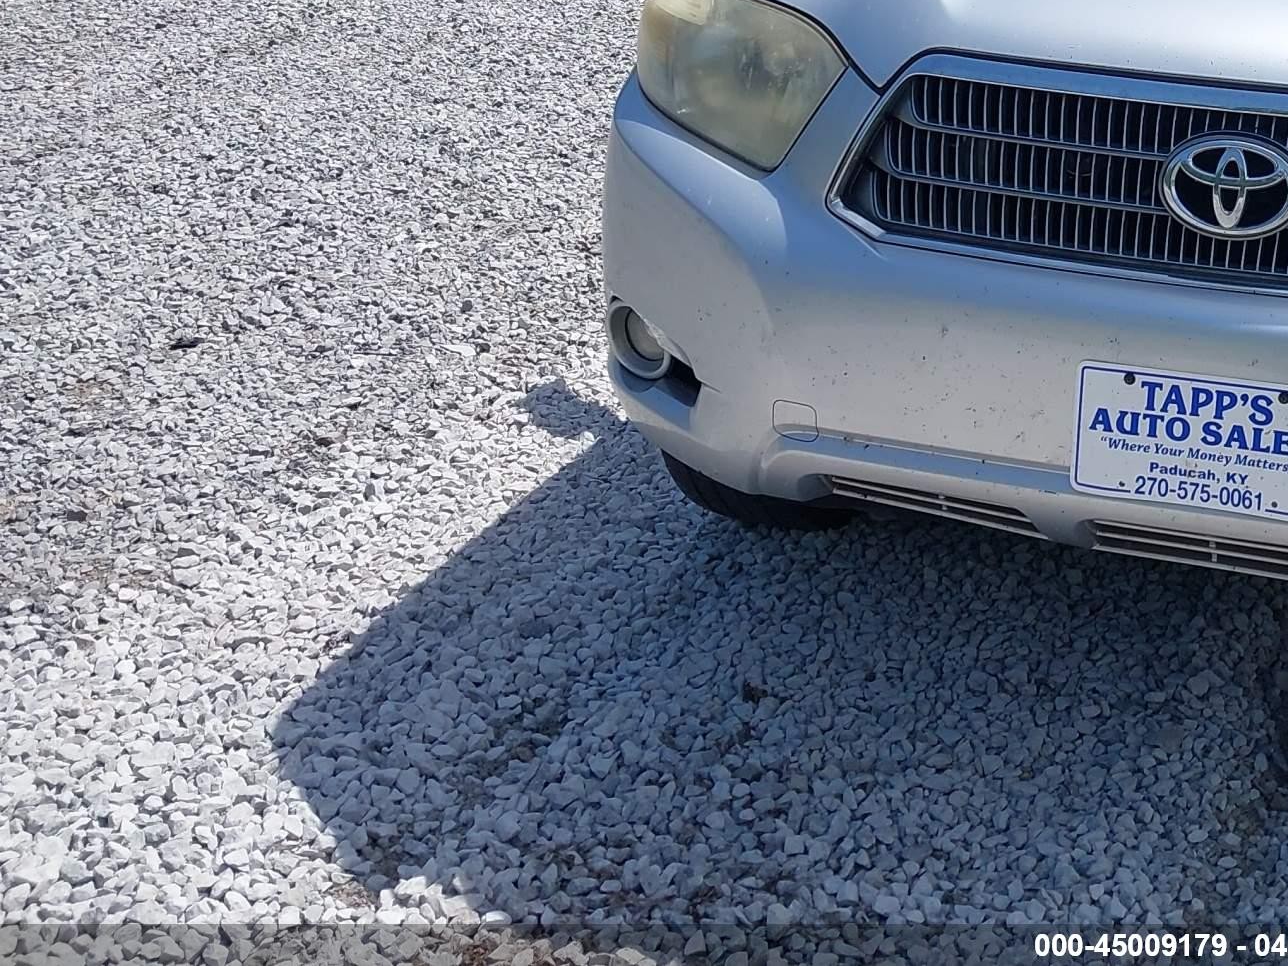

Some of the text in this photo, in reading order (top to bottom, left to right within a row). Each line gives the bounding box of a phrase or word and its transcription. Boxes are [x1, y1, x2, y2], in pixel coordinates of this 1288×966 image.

[1141, 380, 1274, 426] TAPP'S
[1089, 408, 1191, 442] AUTO
[1100, 436, 1150, 454] "Where
[1154, 443, 1184, 458] Your
[1187, 447, 1232, 465] Money
[1149, 462, 1248, 485] Paducah, KY
[1134, 475, 1263, 511] 270-575-0061
